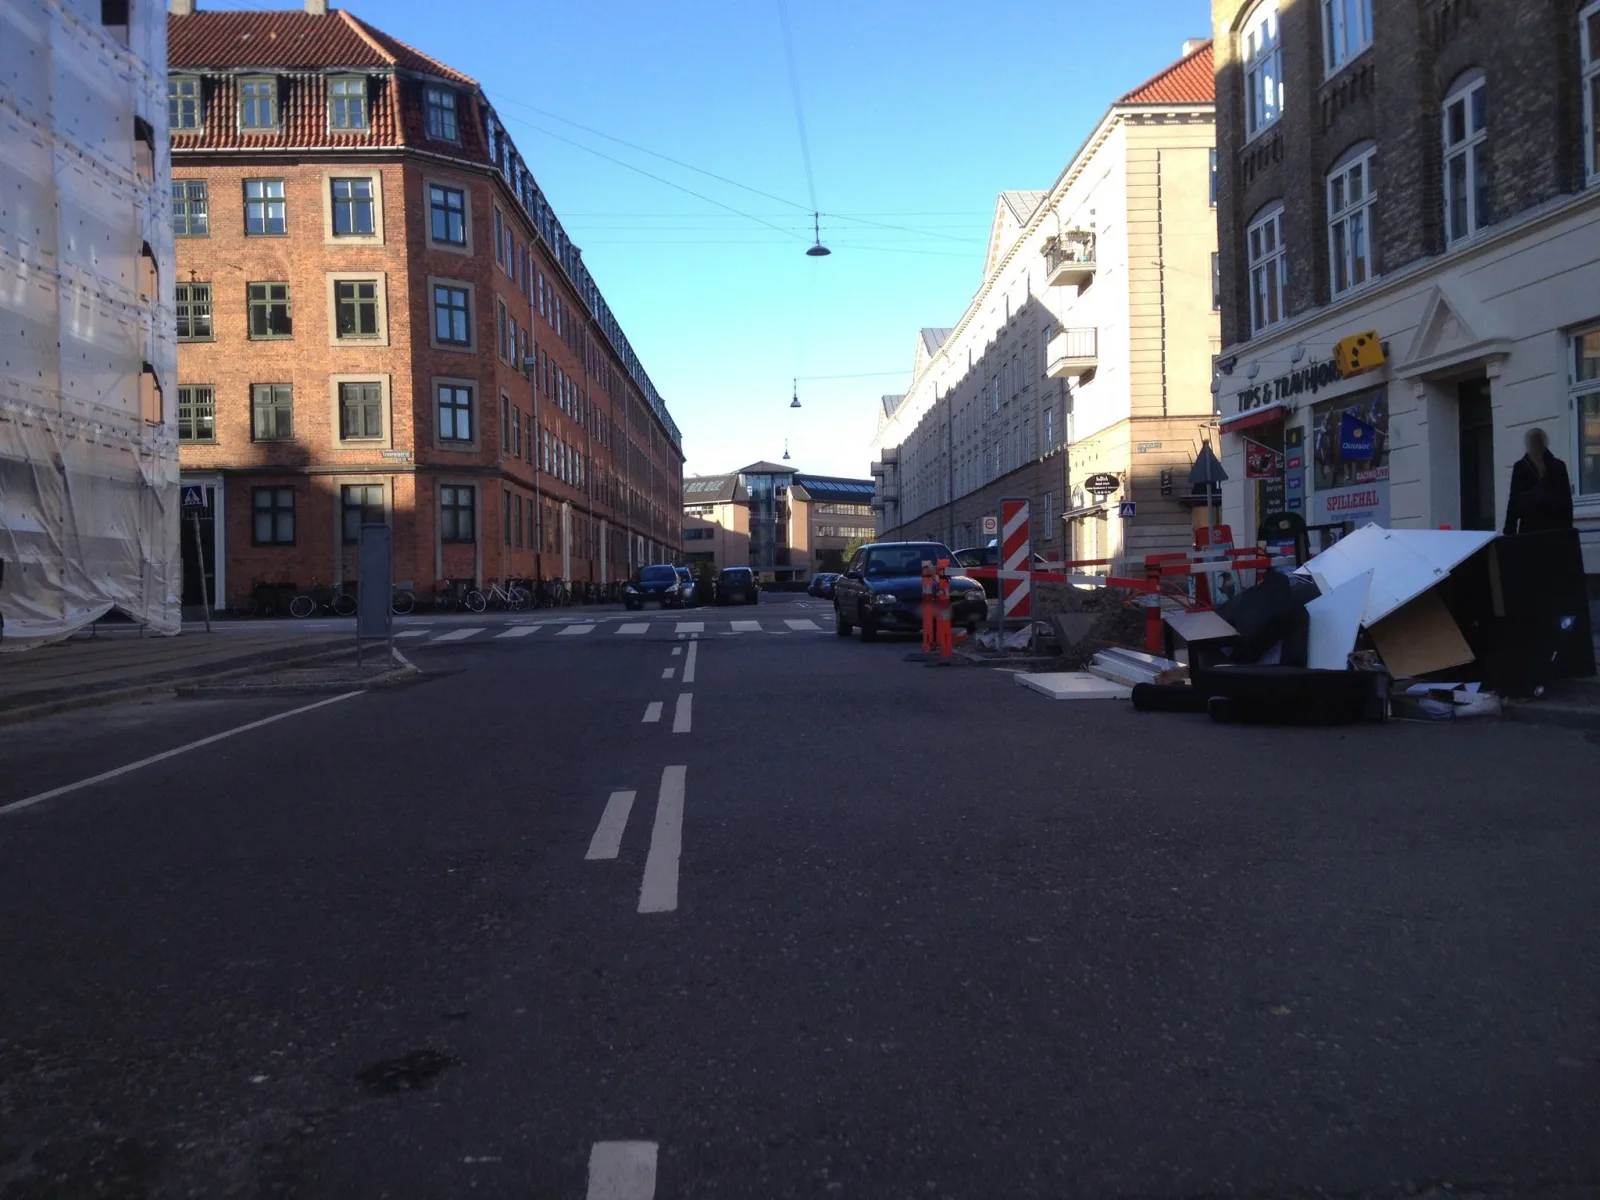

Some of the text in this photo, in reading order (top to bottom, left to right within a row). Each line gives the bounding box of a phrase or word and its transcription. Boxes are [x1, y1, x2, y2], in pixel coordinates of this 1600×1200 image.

[1237, 386, 1261, 412] TIPS
[1262, 382, 1273, 404] &
[1327, 491, 1379, 511] SPILLEHAL
